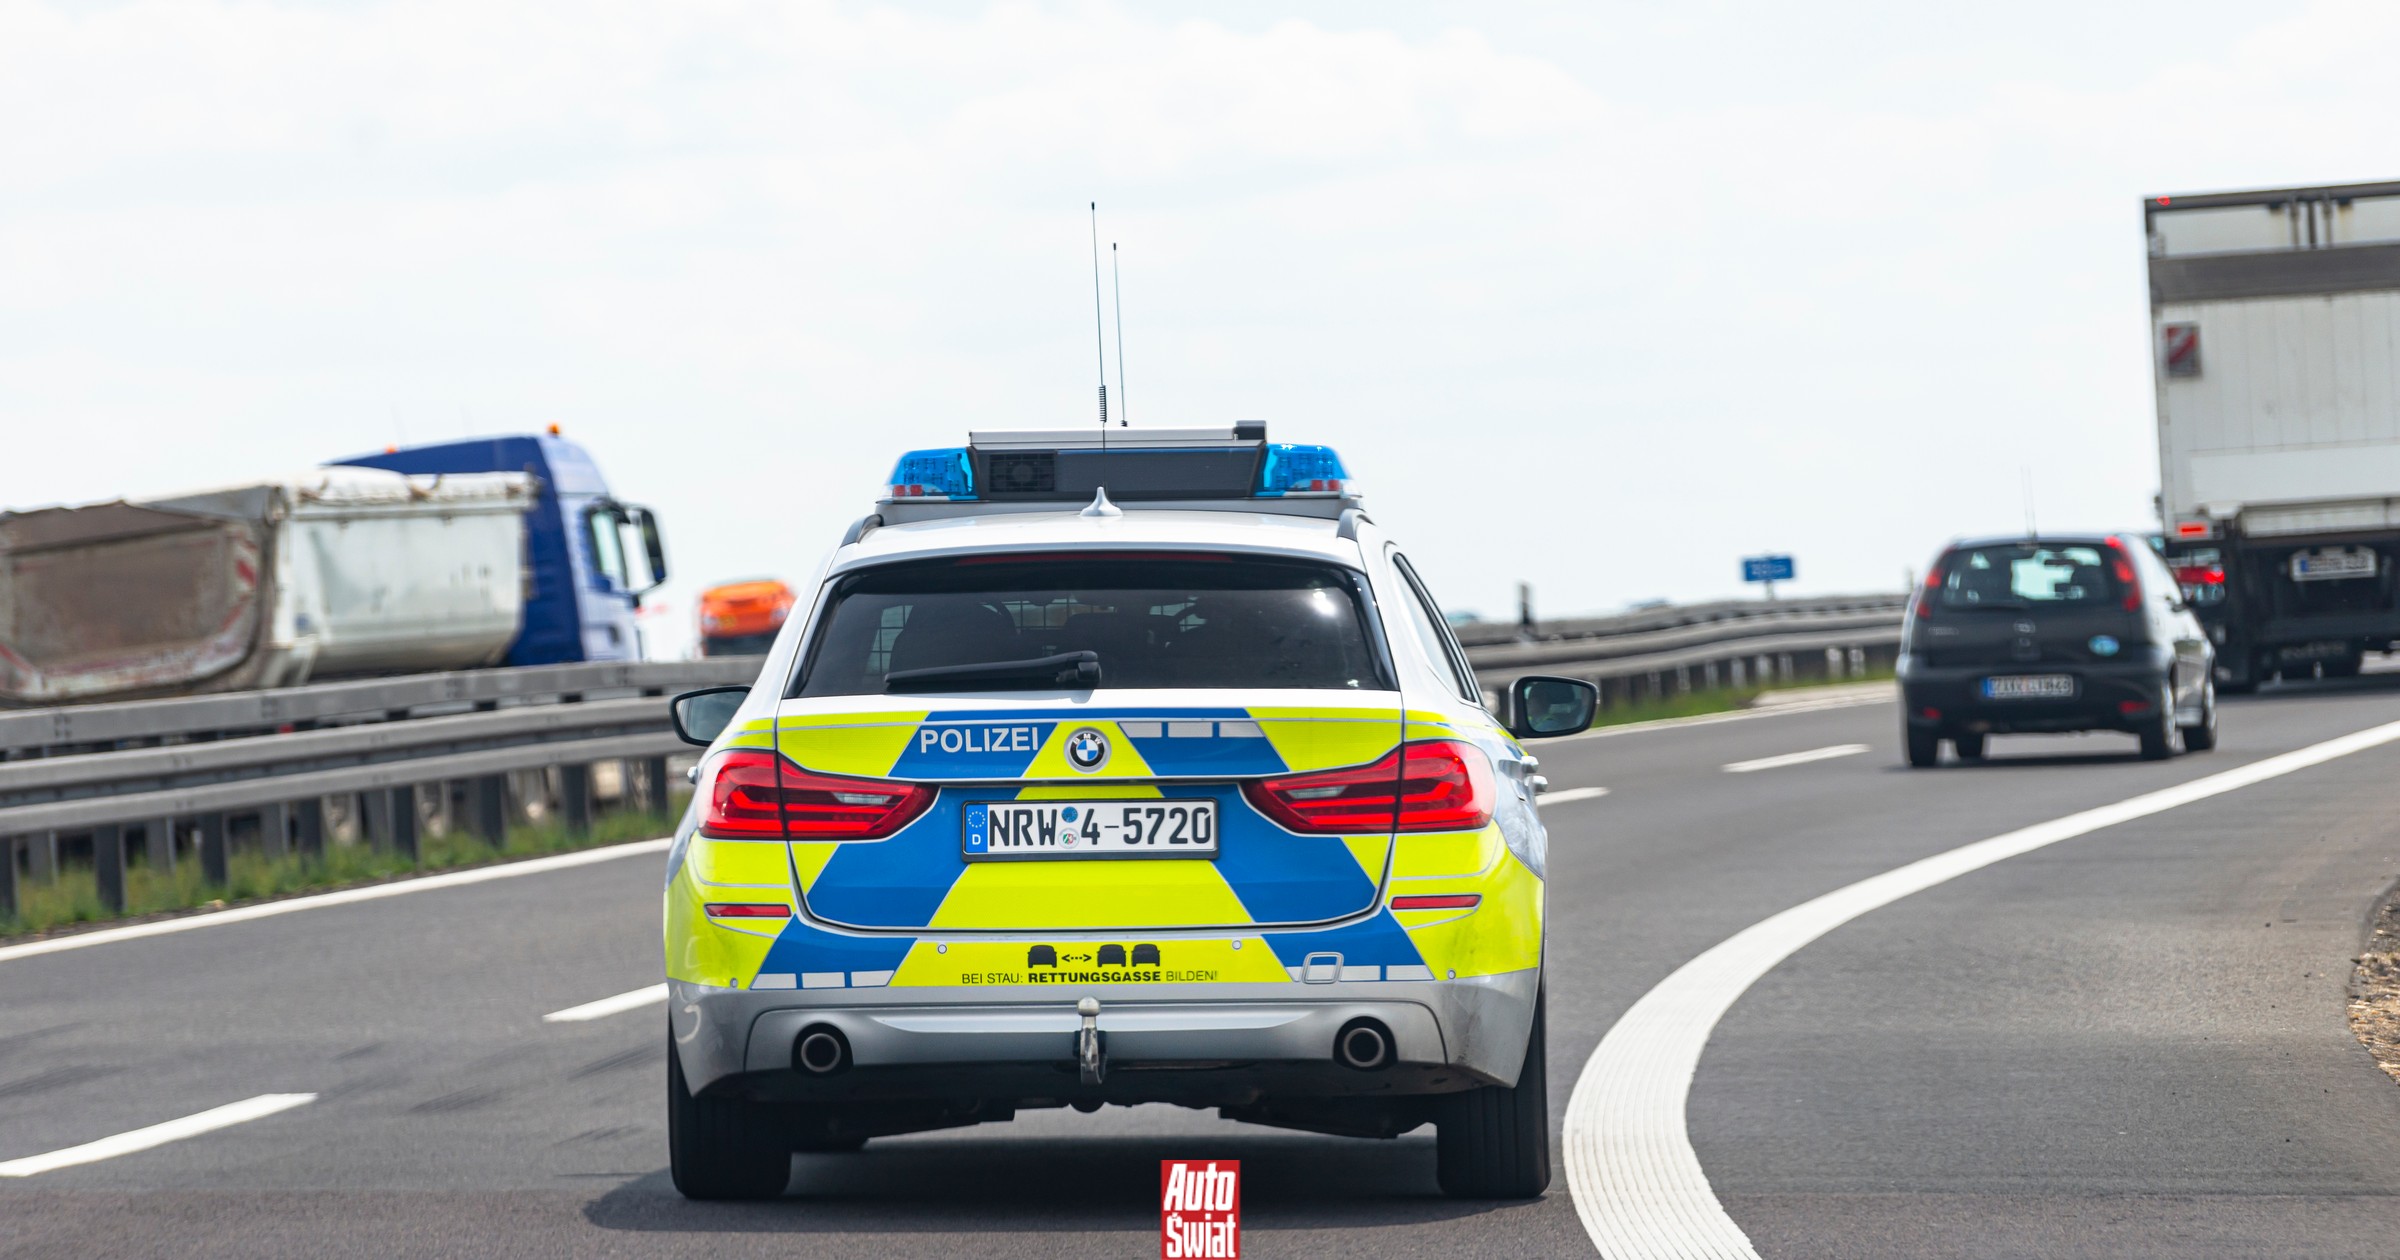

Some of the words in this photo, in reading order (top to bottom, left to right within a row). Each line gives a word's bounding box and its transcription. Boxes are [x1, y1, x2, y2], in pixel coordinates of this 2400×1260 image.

[920, 727, 1039, 754] POLIZEI
[1071, 732, 1103, 746] BMW
[988, 808, 1058, 847] NRW
[1080, 806, 1212, 846] 4-5720
[971, 833, 982, 846] D
[961, 973, 983, 985] BEI
[987, 972, 1023, 984] STAU:
[1028, 971, 1161, 983] RETTUNGSGASSE
[1166, 970, 1218, 982] BILDEN!
